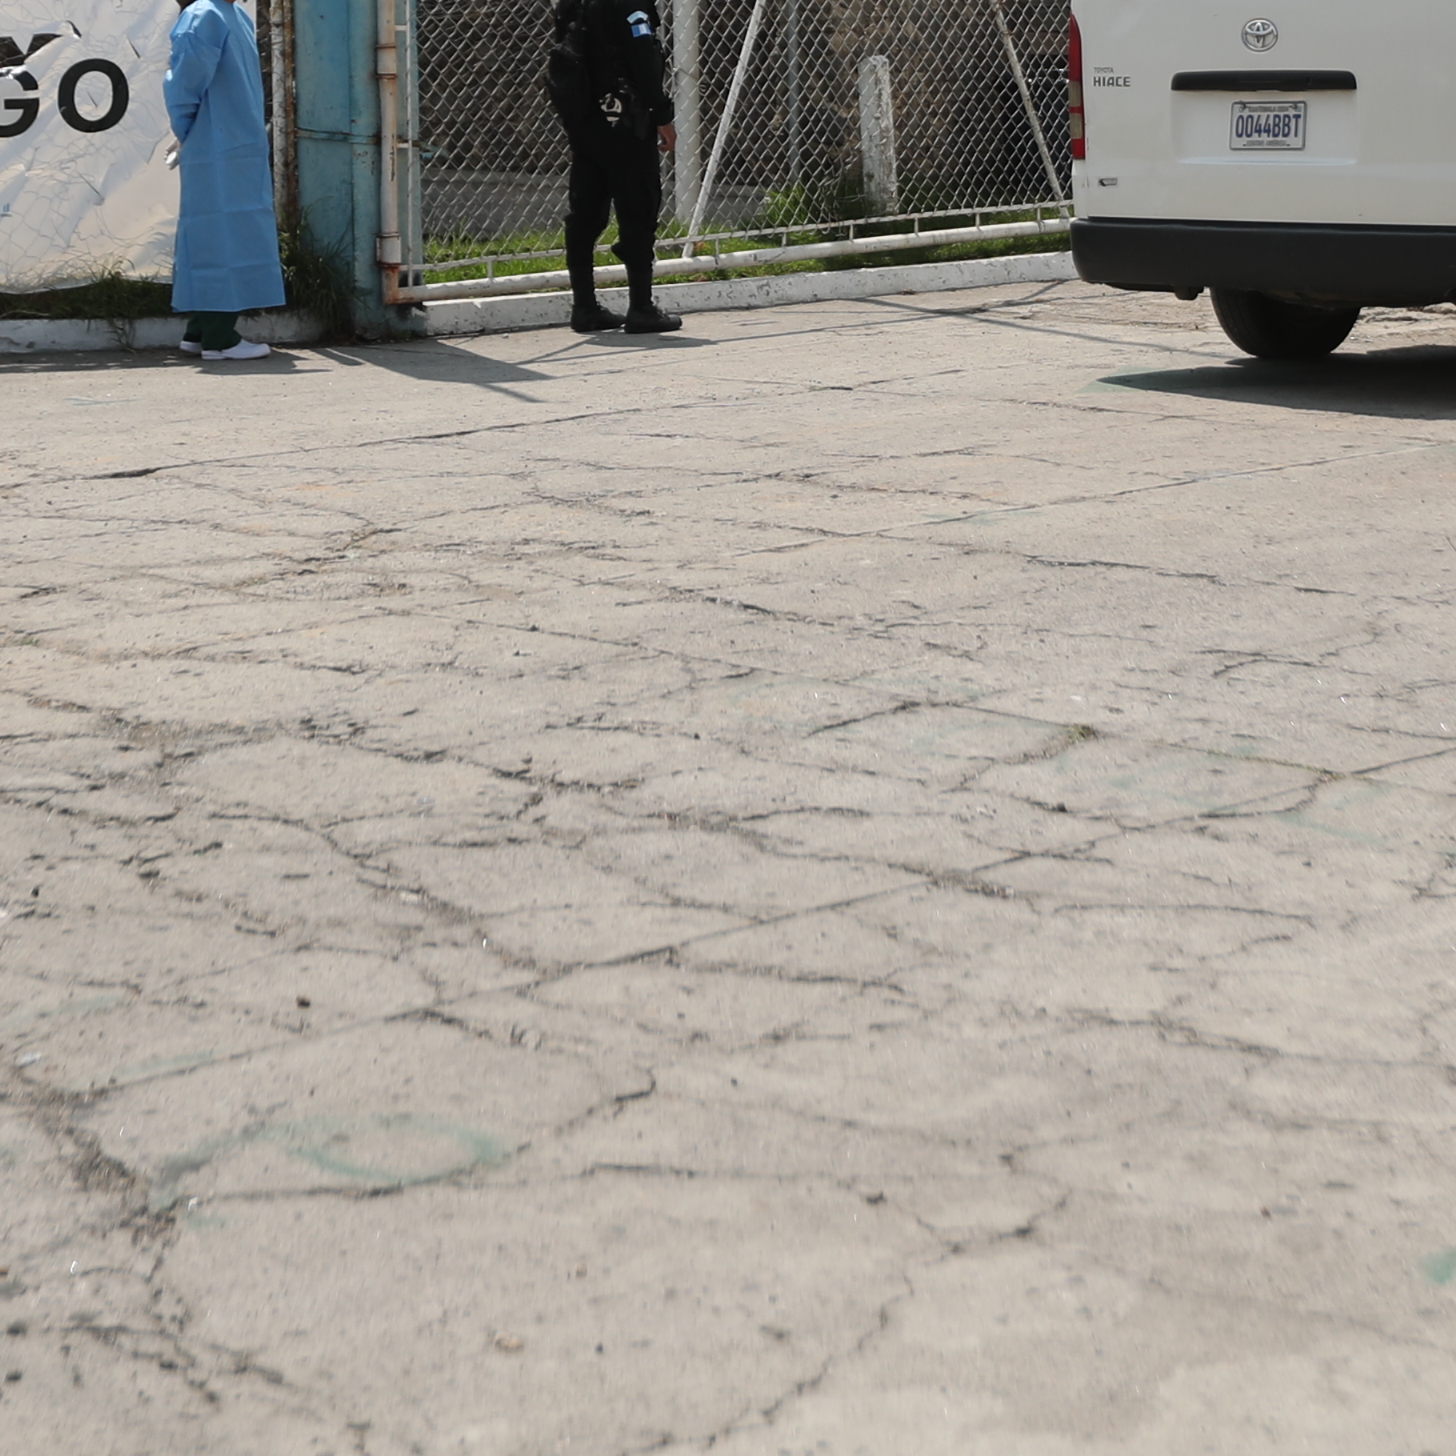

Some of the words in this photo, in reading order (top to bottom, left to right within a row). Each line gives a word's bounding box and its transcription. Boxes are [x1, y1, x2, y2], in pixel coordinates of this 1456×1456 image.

[1093, 66, 1115, 74] TOYOTA
[1092, 76, 1132, 87] HIACE
[1235, 114, 1301, 138] 0044BBT
